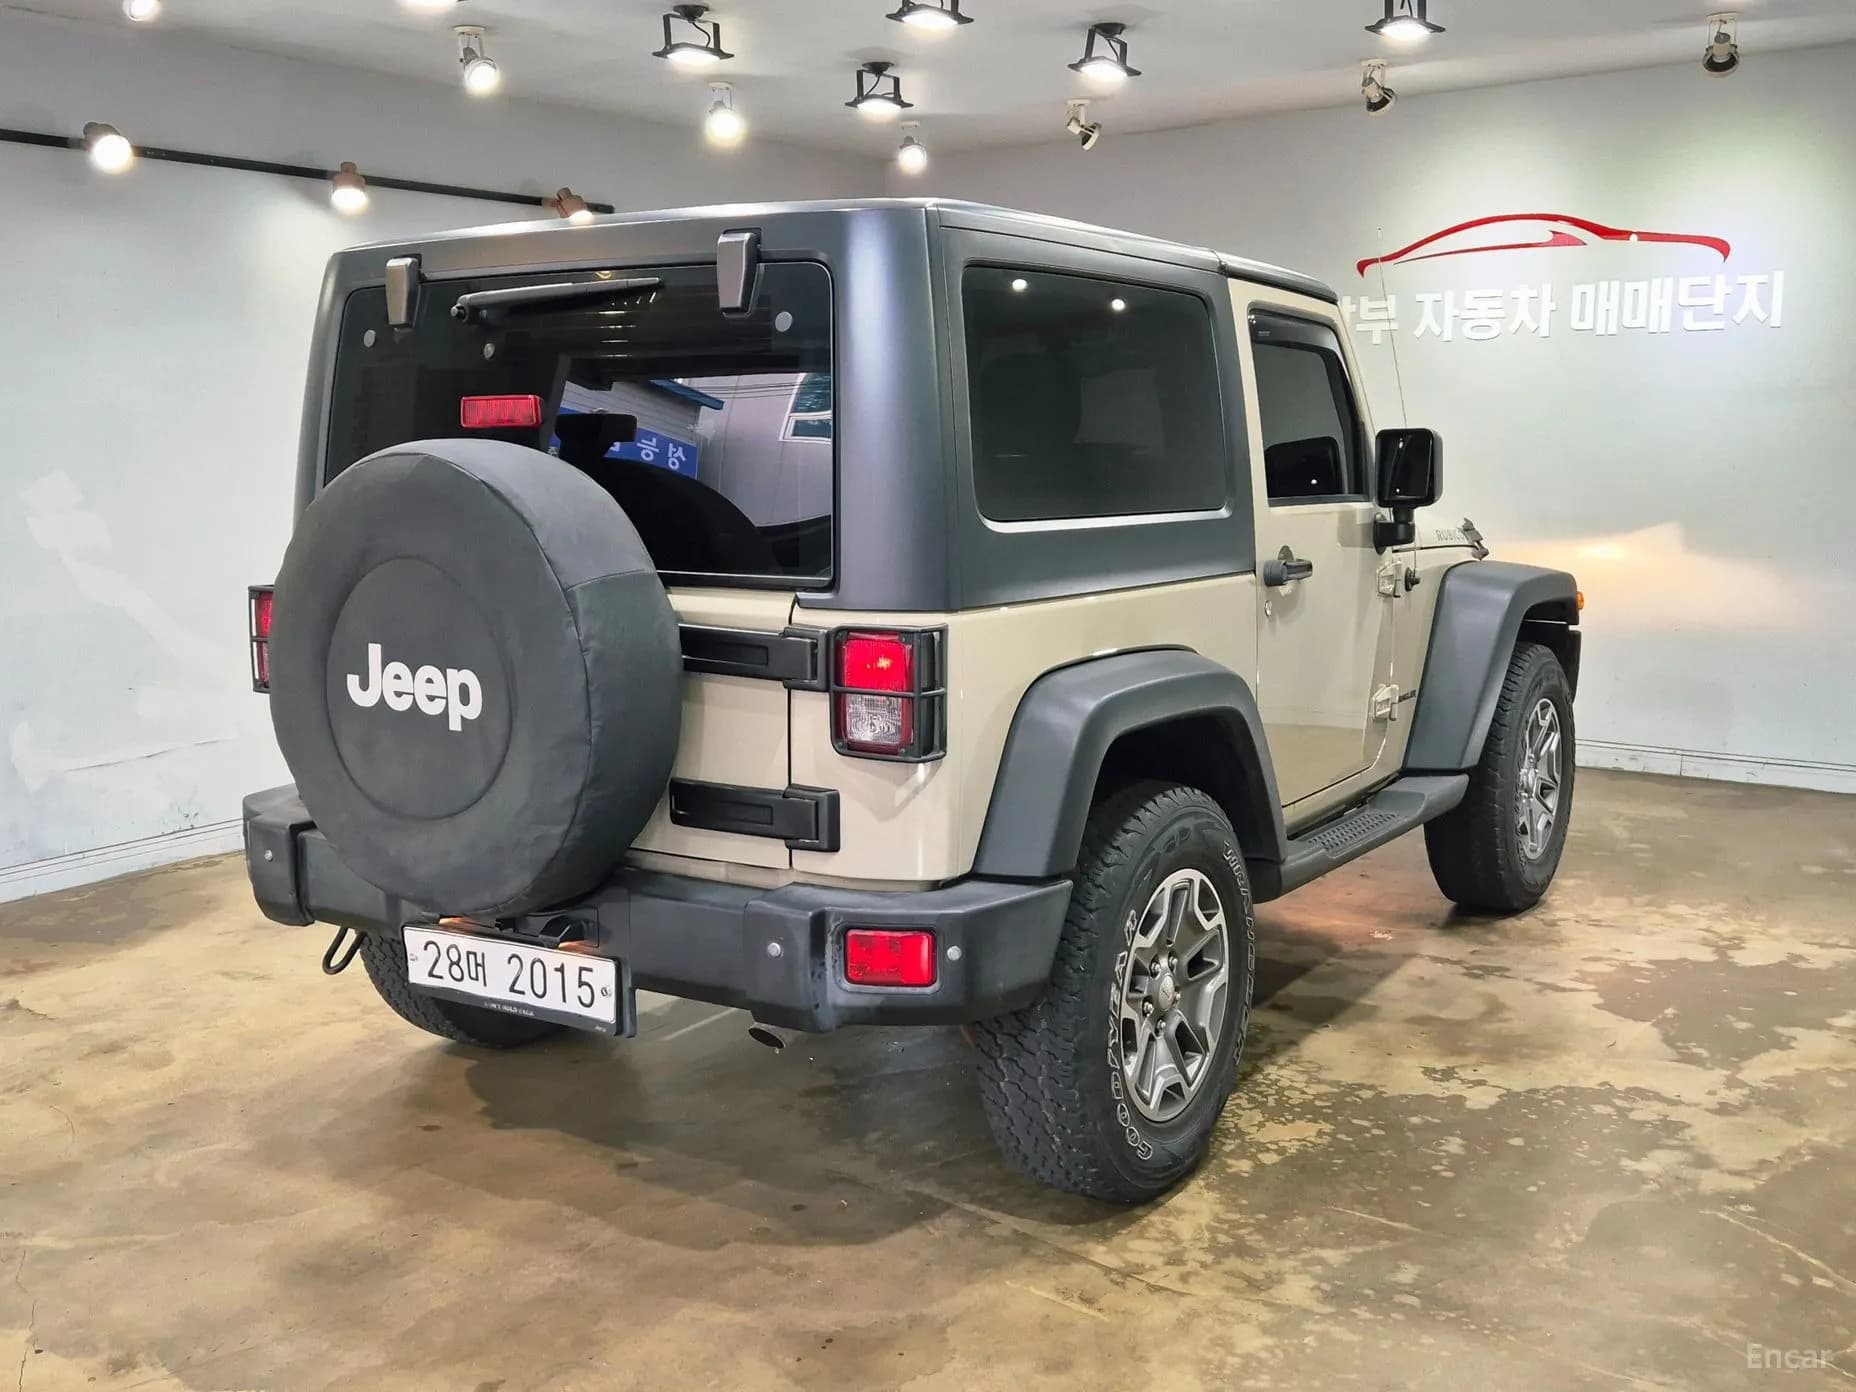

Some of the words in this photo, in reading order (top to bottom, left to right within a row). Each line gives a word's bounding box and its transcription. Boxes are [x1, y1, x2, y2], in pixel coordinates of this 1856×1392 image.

[1413, 283, 1557, 342] 자동차
[1570, 270, 1785, 336] 매매단지
[346, 642, 483, 731] Jeep
[422, 940, 488, 988] 28머
[507, 952, 595, 1008] 2015
[1107, 909, 1153, 1159] GOODYEAR
